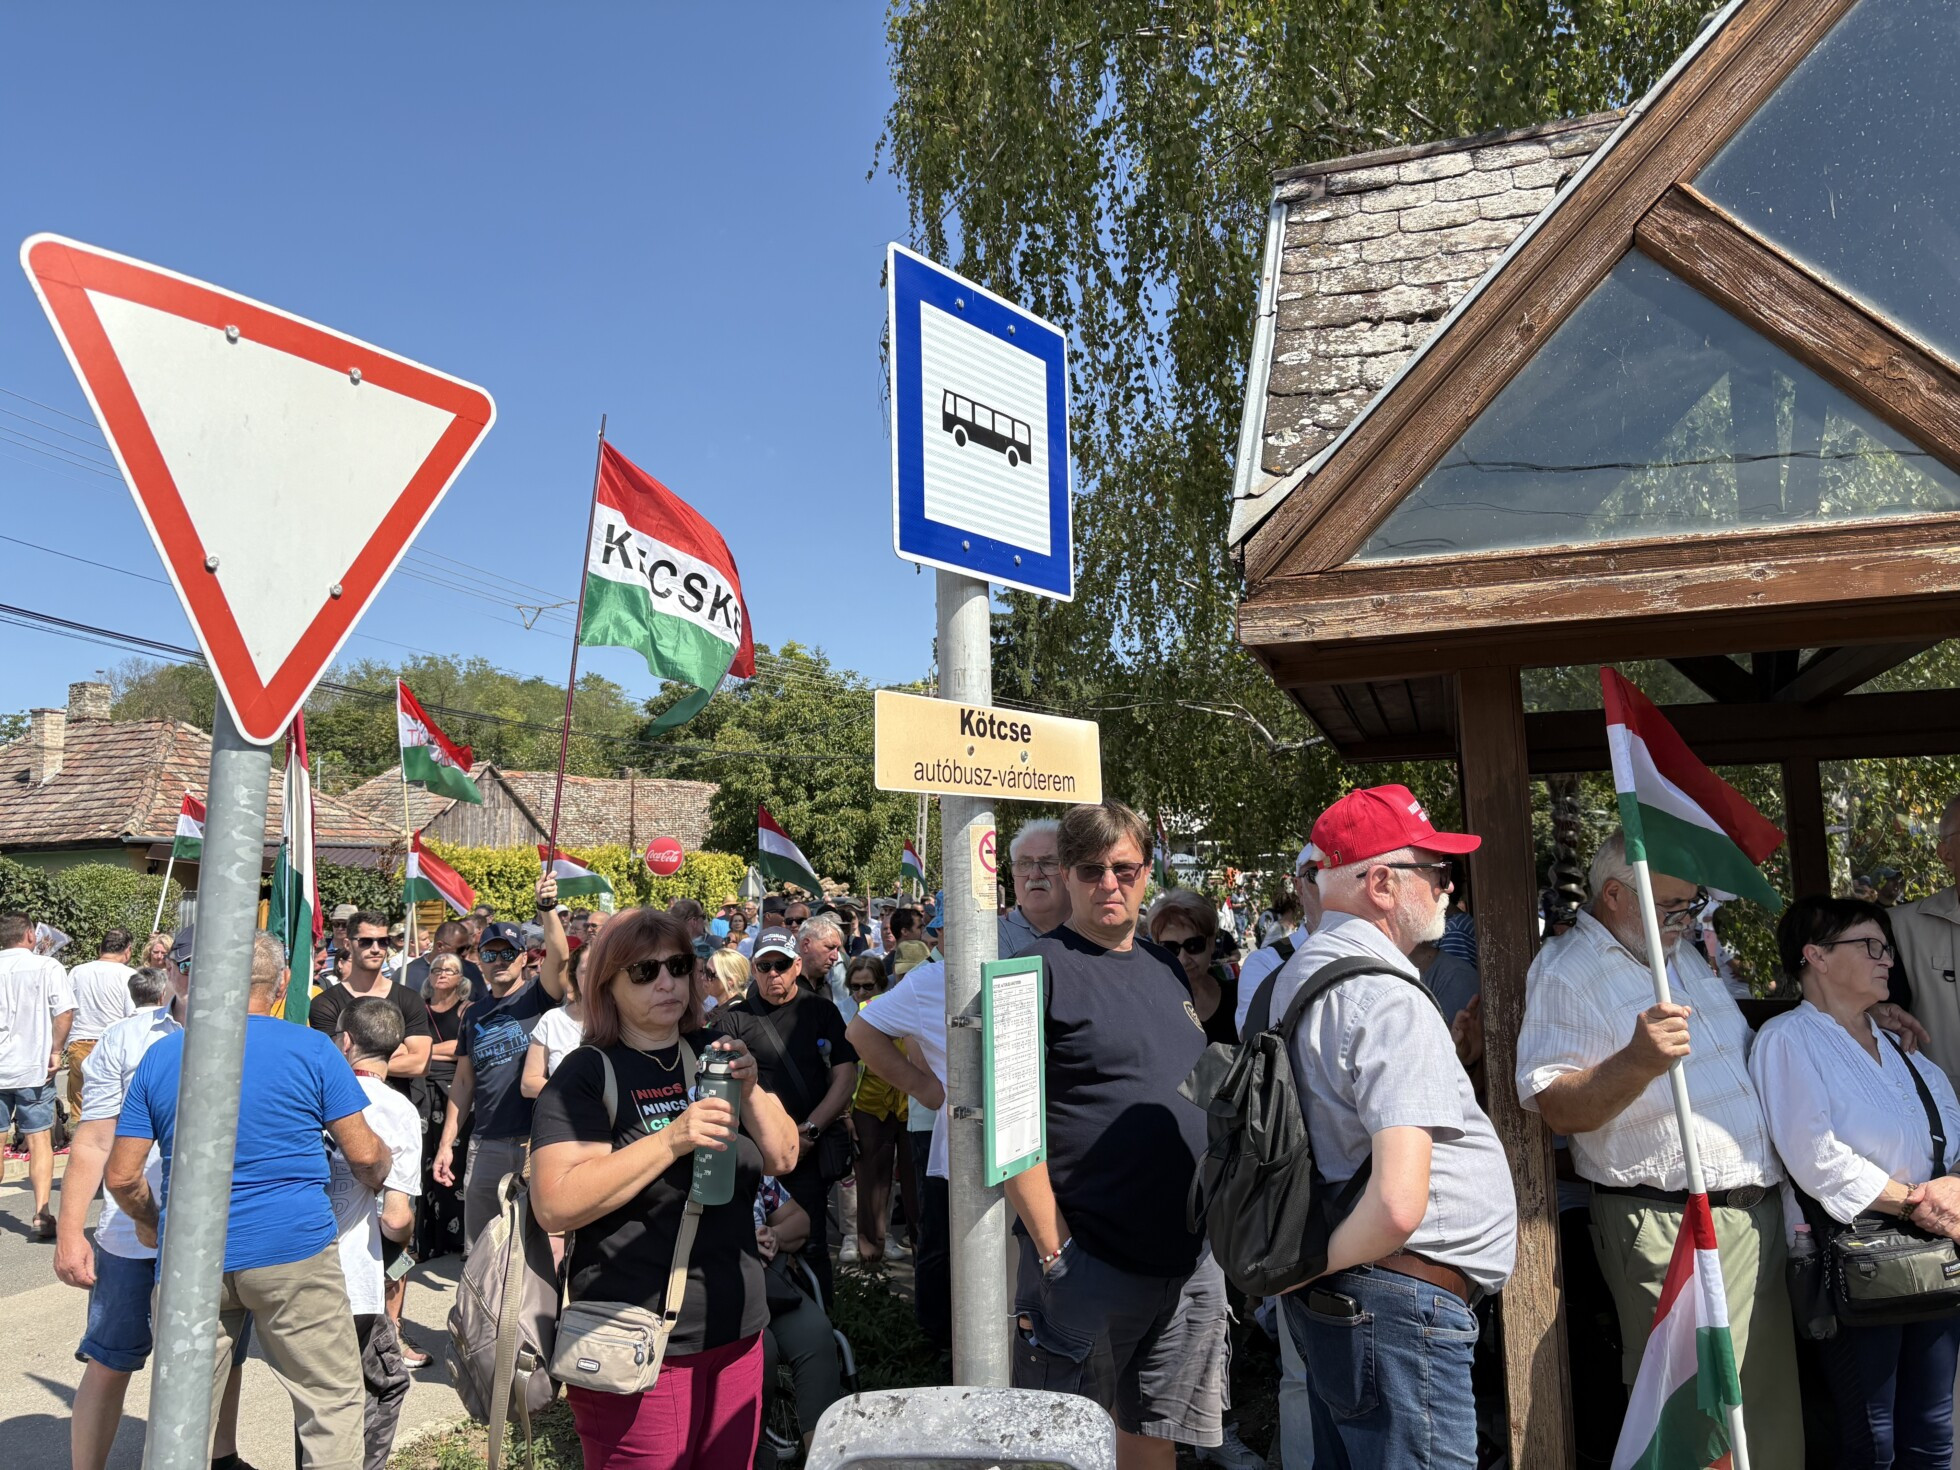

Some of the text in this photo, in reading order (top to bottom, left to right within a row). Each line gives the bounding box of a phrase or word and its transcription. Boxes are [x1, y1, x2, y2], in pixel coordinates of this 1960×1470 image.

[960, 708, 1032, 743] Kötcse
[914, 758, 1076, 793] autóbusz-váróterem
[636, 1083, 683, 1100] NINCS
[642, 1099, 688, 1116] NINCS
[650, 1116, 677, 1131] CS
